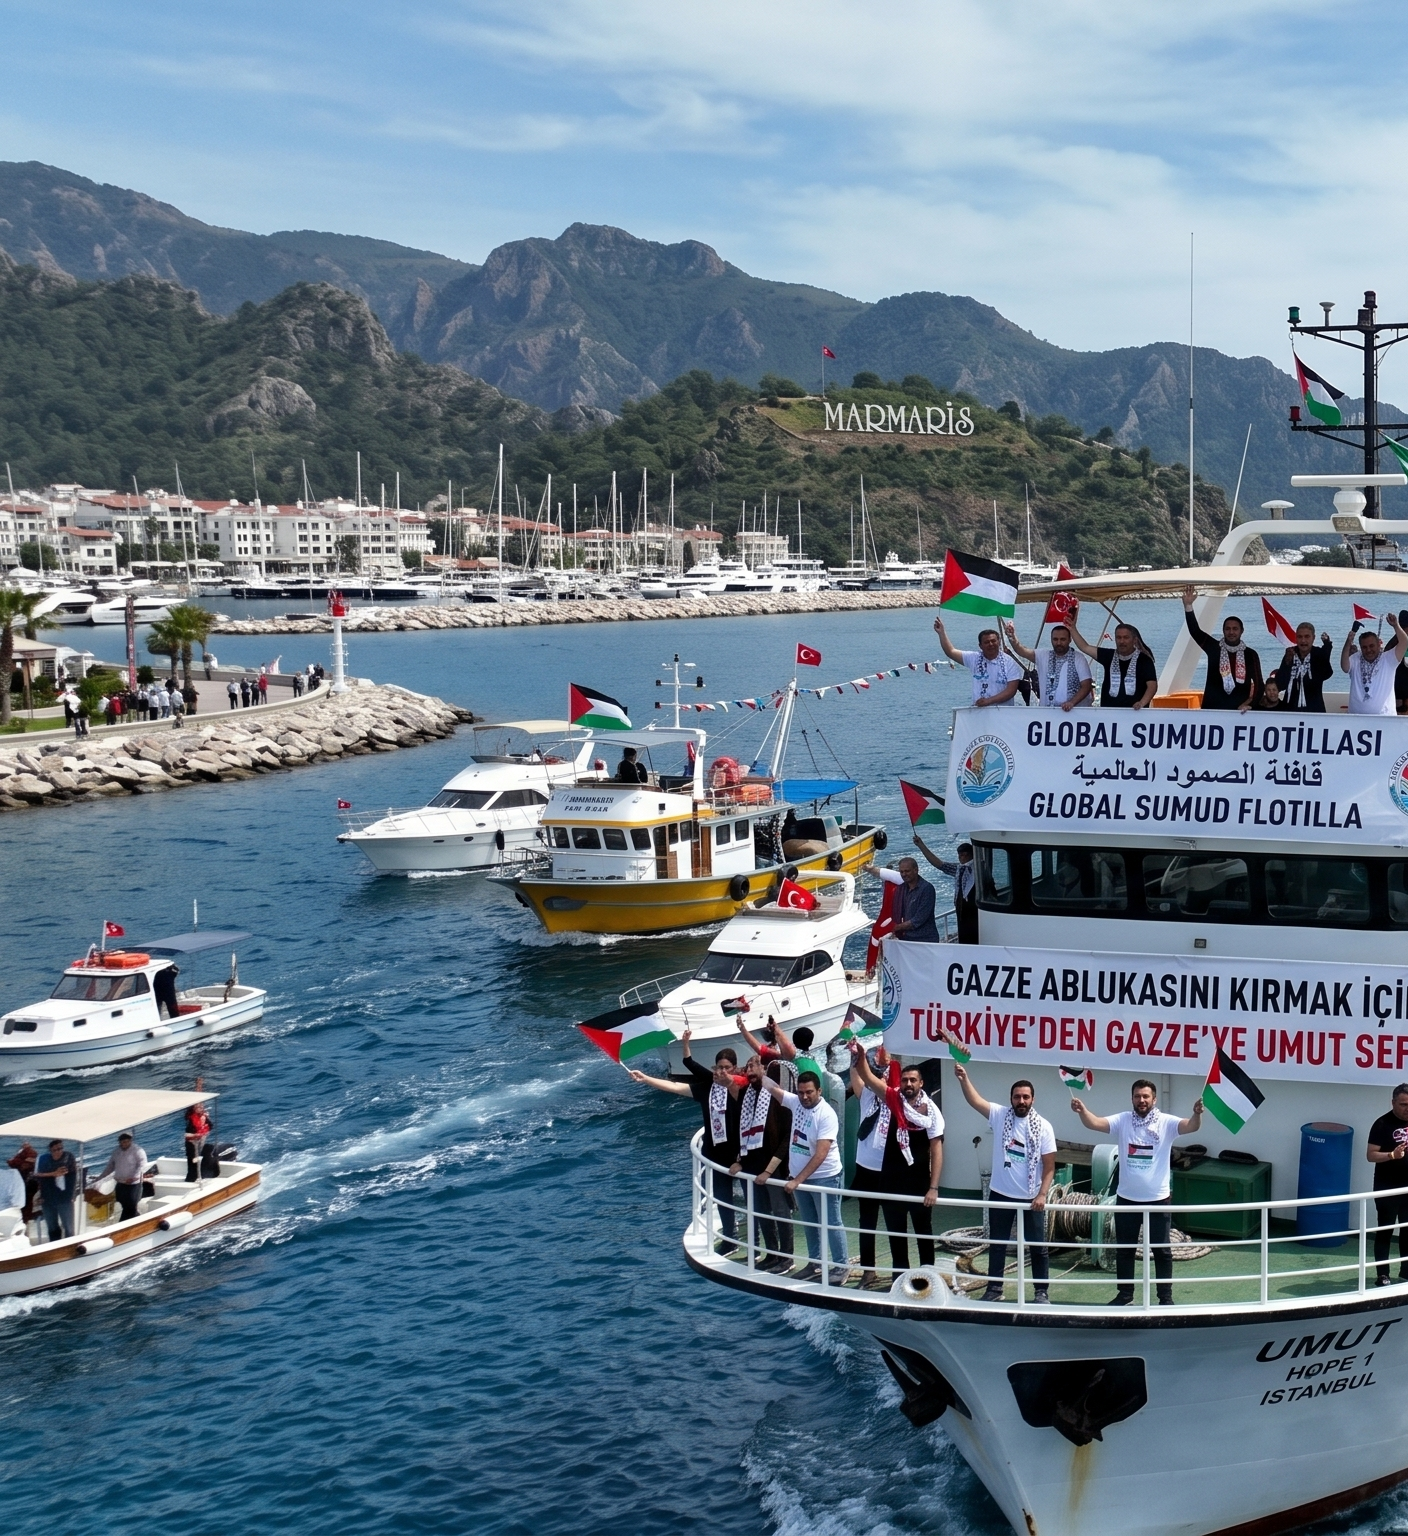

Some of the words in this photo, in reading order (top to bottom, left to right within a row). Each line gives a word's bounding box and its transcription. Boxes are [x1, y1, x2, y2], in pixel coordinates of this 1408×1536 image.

[1027, 720, 1124, 748] GLOBAL
[1131, 722, 1225, 751] SUMUD
[1232, 721, 1383, 757] FLOTİLLASI
[1071, 753, 1156, 787] العالمية
[1166, 760, 1255, 789] الصمود
[1264, 758, 1323, 787] قافلة
[1029, 792, 1127, 820] GLOBAL
[1134, 794, 1230, 823] SUMUD
[1238, 797, 1363, 829] FLOTILLA
[946, 962, 1033, 1000] GAZZE
[1038, 967, 1220, 1010] ABLUKASINI
[1229, 976, 1353, 1017] KIRMAK
[910, 1002, 1096, 1052] TÜRKİYE'DEN
[1106, 1020, 1247, 1061] GAZZE'YE
[1257, 1029, 1346, 1066] UMUT
[1255, 1317, 1403, 1363] UMUT
[1285, 1355, 1358, 1382] HOPE
[1363, 1352, 1375, 1367] 1
[1259, 1372, 1377, 1406] ISTANBUL
